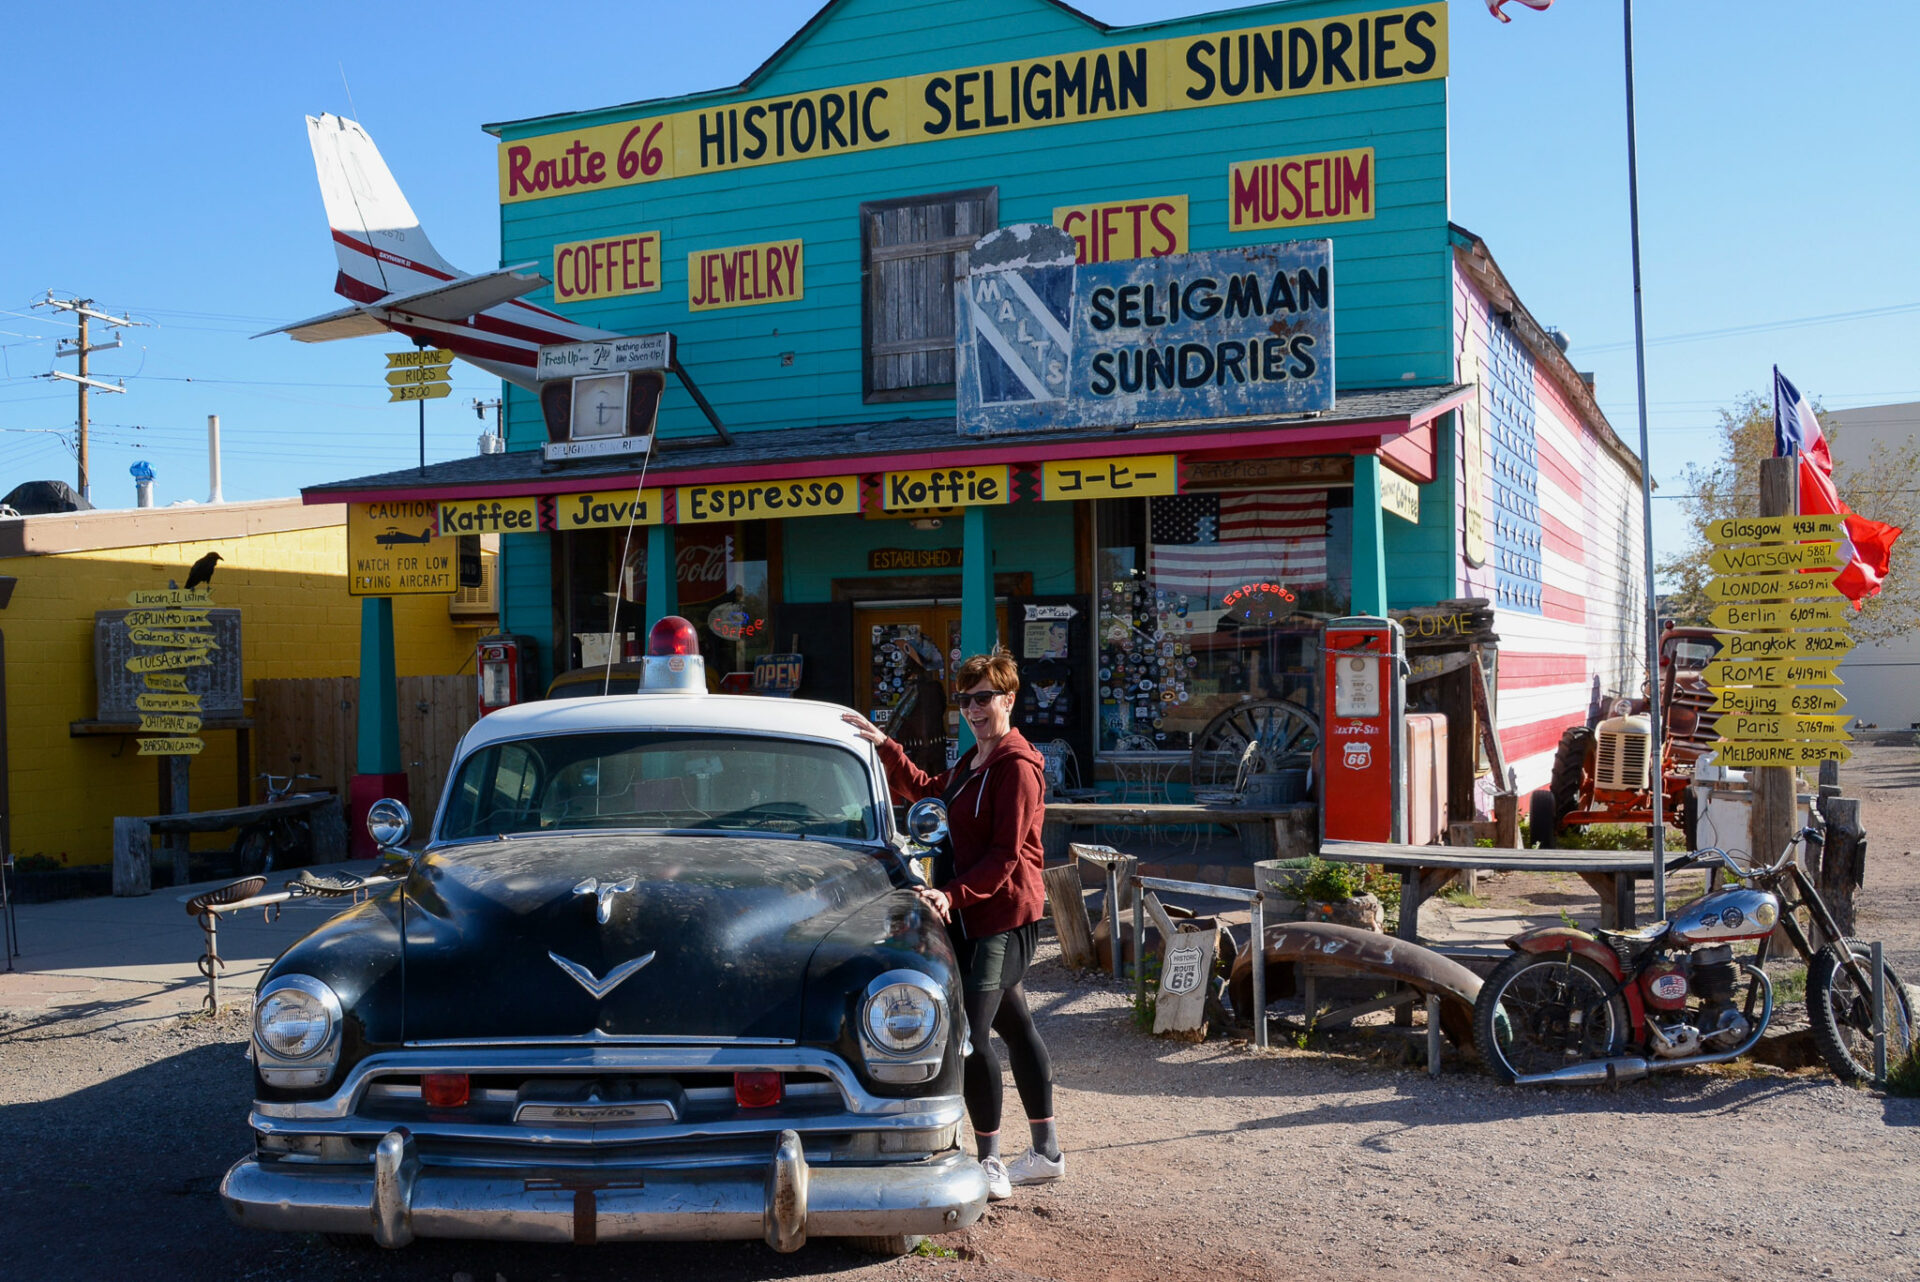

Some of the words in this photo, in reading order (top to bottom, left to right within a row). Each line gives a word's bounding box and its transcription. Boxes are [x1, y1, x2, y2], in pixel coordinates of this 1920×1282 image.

[507, 139, 606, 197] Route
[616, 121, 664, 180] 66
[698, 87, 890, 169] HISTORIC
[922, 47, 1149, 136] SELIGMAN
[1184, 10, 1438, 102] SUNDRIES
[1232, 152, 1371, 226] MUSEUM
[1062, 202, 1178, 265] GIFTS
[556, 235, 656, 298] COFFEE
[691, 243, 801, 307] JEWELRY
[1090, 265, 1329, 332] SELIGMAN
[976, 277, 1065, 387] MALTS
[394, 350, 443, 366] AIRPLANE
[1090, 334, 1317, 397] SUNDRIES
[405, 369, 436, 383] RIDES
[890, 469, 999, 506] Koffie
[1057, 463, 1158, 492] コーヒー
[368, 502, 435, 520] CAUTION
[571, 494, 649, 526] Java
[689, 481, 845, 520] Espresso
[441, 502, 534, 534] Kaffee
[1720, 521, 1782, 540] Glasgow
[356, 557, 390, 572] WATCH
[397, 557, 418, 571] FOR
[425, 556, 449, 570] LOW
[872, 549, 952, 570] ESTABLISHED
[1722, 549, 1804, 570] Warsaw
[355, 574, 392, 590] FLYING
[399, 573, 451, 588] AIRCRAFT
[1721, 580, 1780, 597] LONDON
[1223, 582, 1296, 608] Espresso
[1727, 607, 1776, 625] Berlin
[713, 617, 765, 640] Coffee
[1730, 635, 1797, 656] Bangkok
[755, 662, 801, 689] OPEN
[1721, 665, 1777, 683] ROME
[1721, 690, 1777, 712] Beijing
[1736, 717, 1780, 734] Paris
[1347, 753, 1367, 766] 66
[1721, 744, 1796, 762] MELBOURNE
[1173, 954, 1198, 964] HISTORIC
[1173, 964, 1196, 974] ROUTE
[1171, 973, 1194, 989] 66
